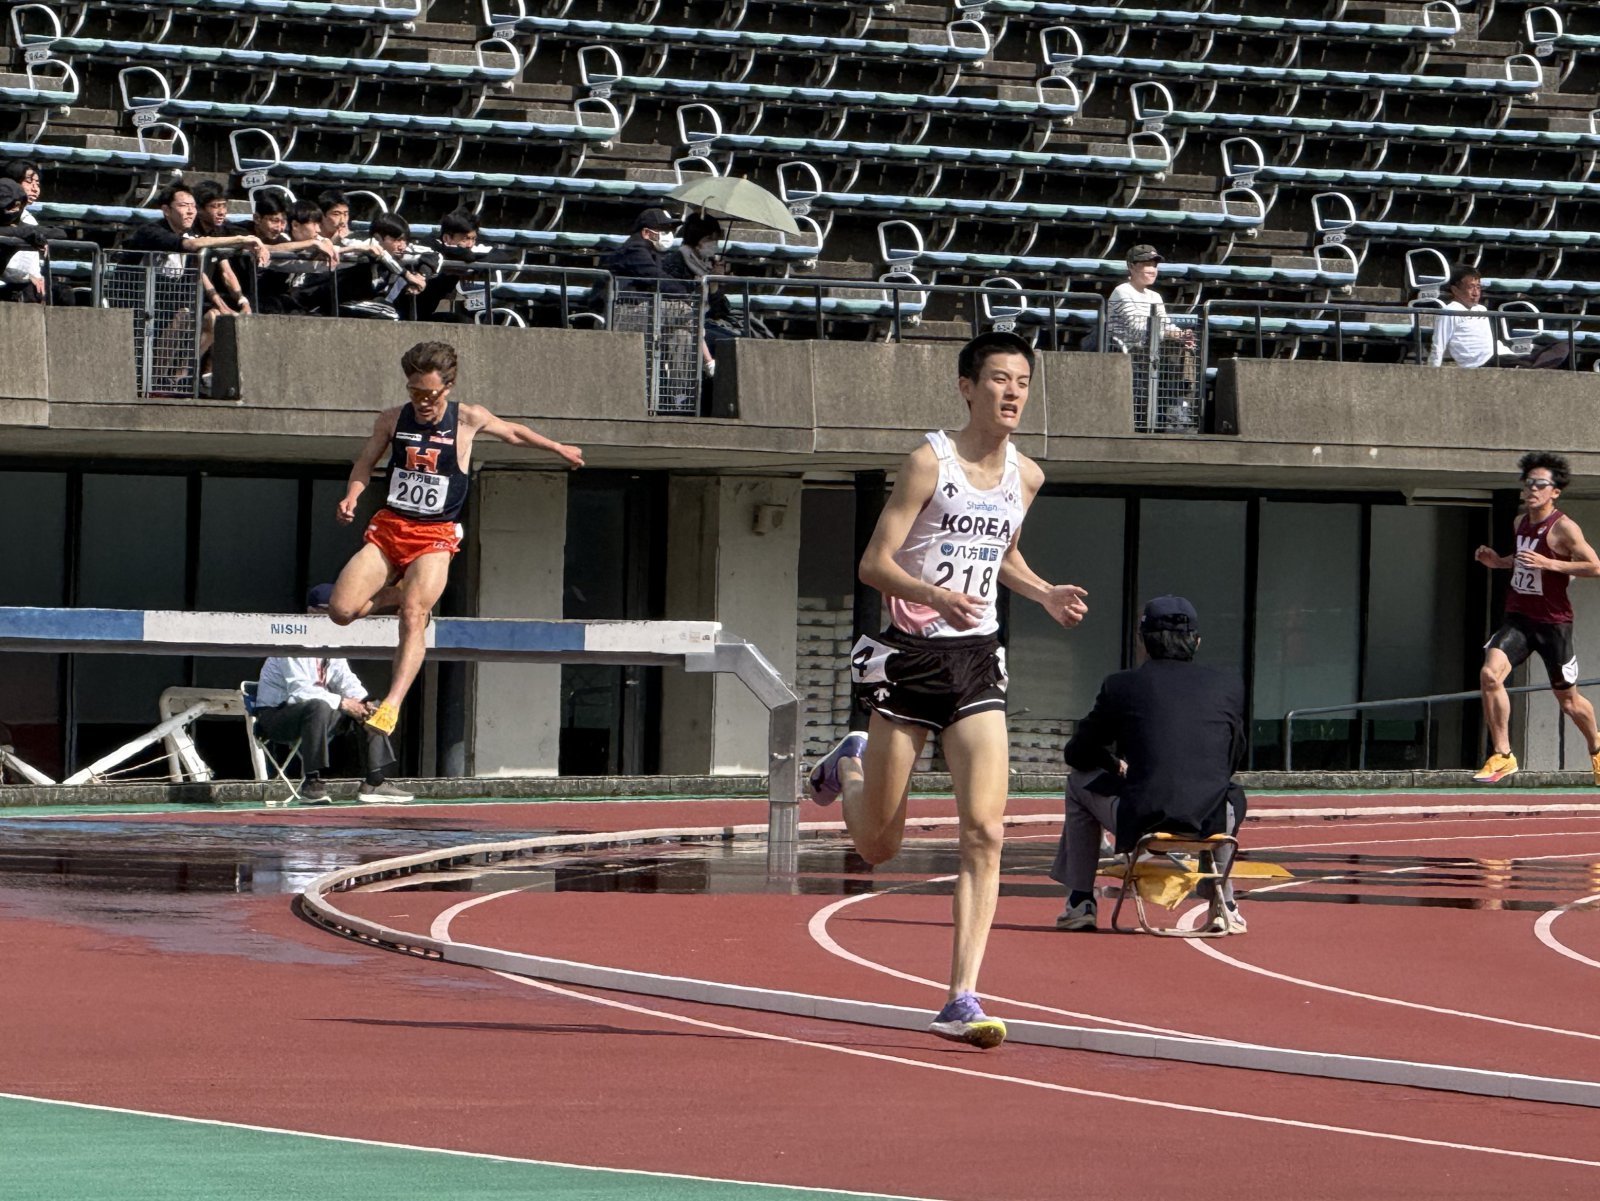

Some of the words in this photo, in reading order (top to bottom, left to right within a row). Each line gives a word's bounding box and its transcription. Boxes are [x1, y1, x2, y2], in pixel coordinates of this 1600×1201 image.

[405, 446, 441, 473] H
[396, 481, 438, 507] 206
[940, 513, 1010, 540] KOREA
[934, 561, 993, 597] 218
[271, 623, 307, 635] NISHI
